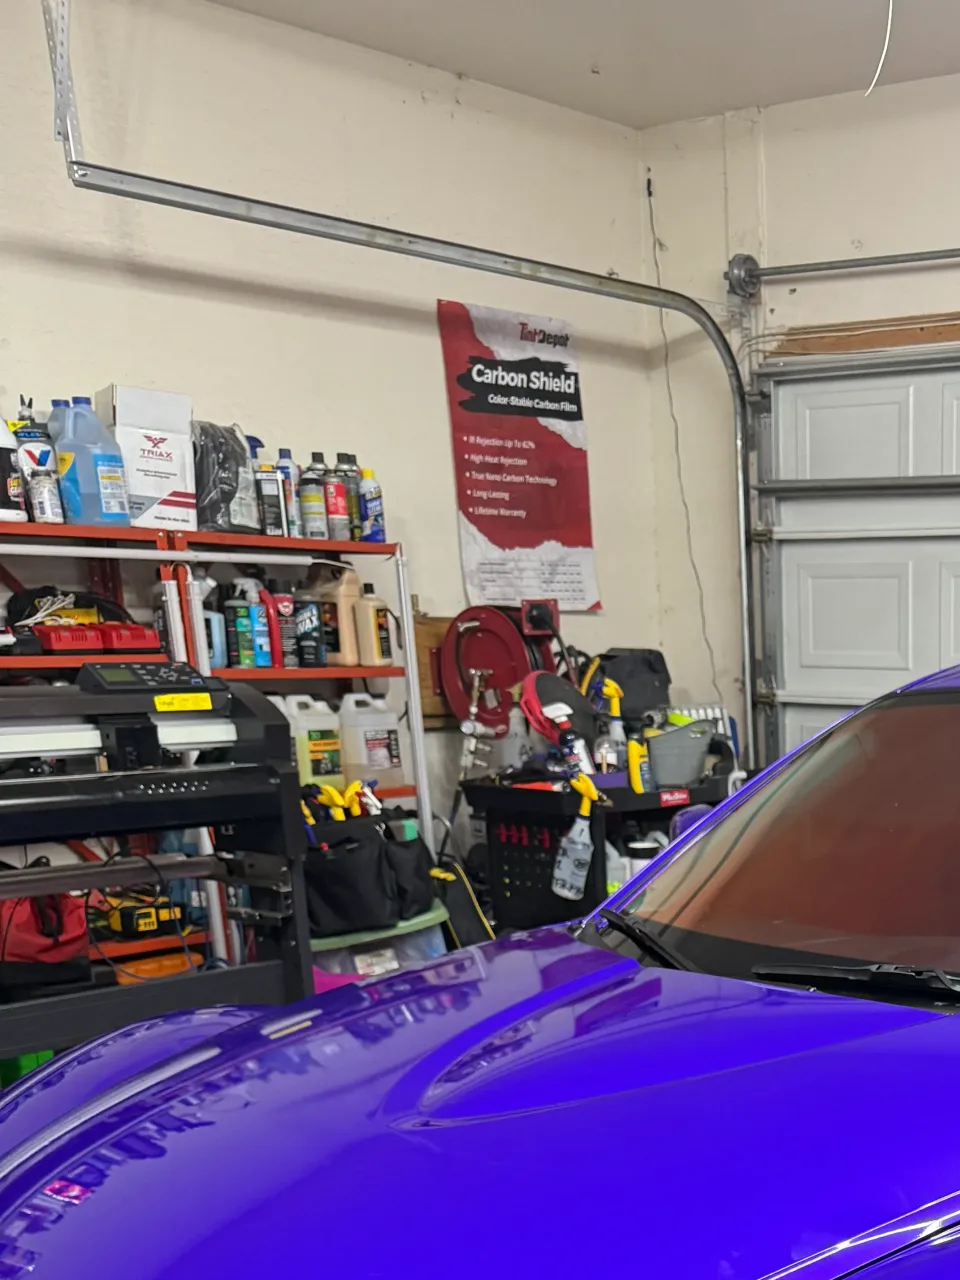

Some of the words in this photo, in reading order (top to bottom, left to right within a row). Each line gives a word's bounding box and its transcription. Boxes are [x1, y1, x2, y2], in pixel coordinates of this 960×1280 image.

[471, 363, 528, 388] Carbon
[529, 371, 576, 394] Shield
[487, 393, 533, 408] Color-Stable
[534, 398, 559, 410] Carbon
[560, 402, 578, 413] Film
[476, 436, 503, 447] Rejection
[140, 448, 173, 459] TRIAX
[500, 456, 528, 467] Rejection
[502, 473, 524, 483] Carbon
[525, 475, 557, 487] Technology
[474, 506, 498, 516] Lifetime
[499, 507, 527, 519] Warranty
